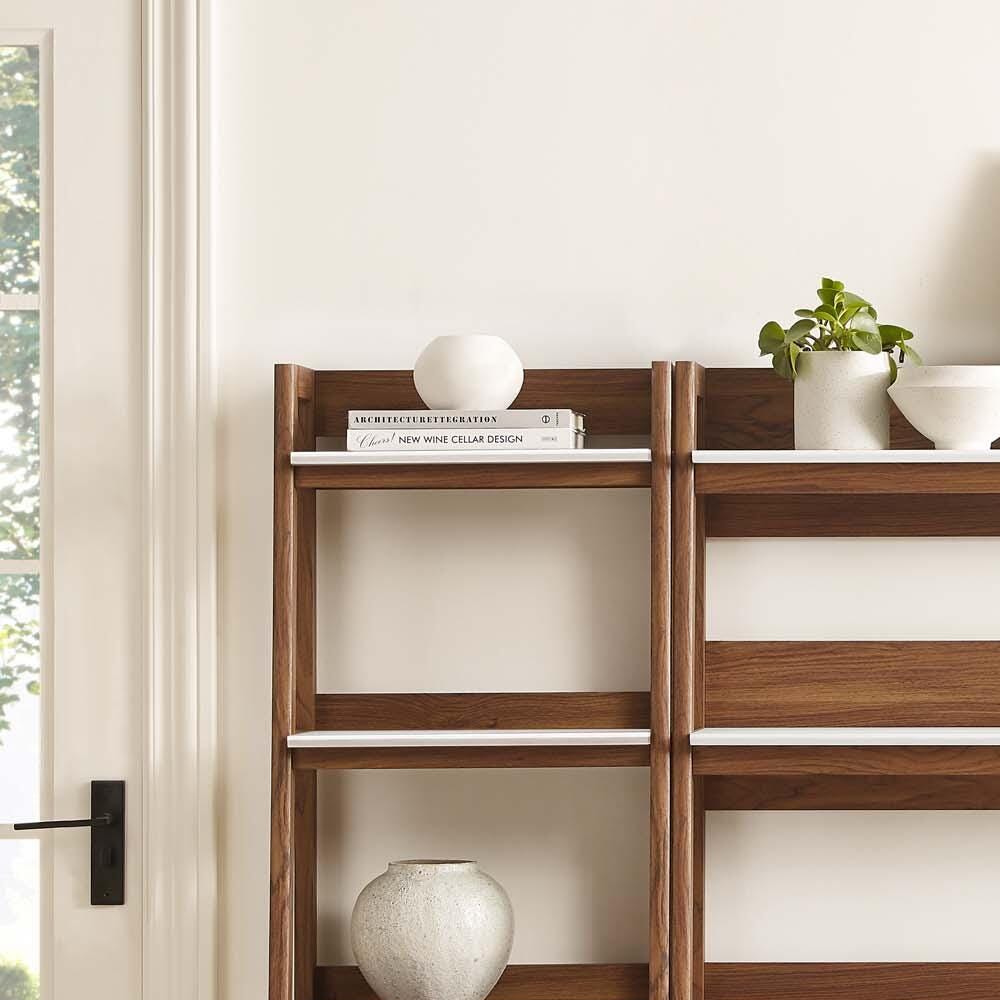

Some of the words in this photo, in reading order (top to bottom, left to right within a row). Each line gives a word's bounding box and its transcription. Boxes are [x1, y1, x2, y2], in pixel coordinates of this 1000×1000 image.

[398, 435, 421, 444] NEW
[423, 435, 449, 444] WINE
[451, 435, 485, 444] CELLAR
[487, 435, 523, 444] DESIGN
